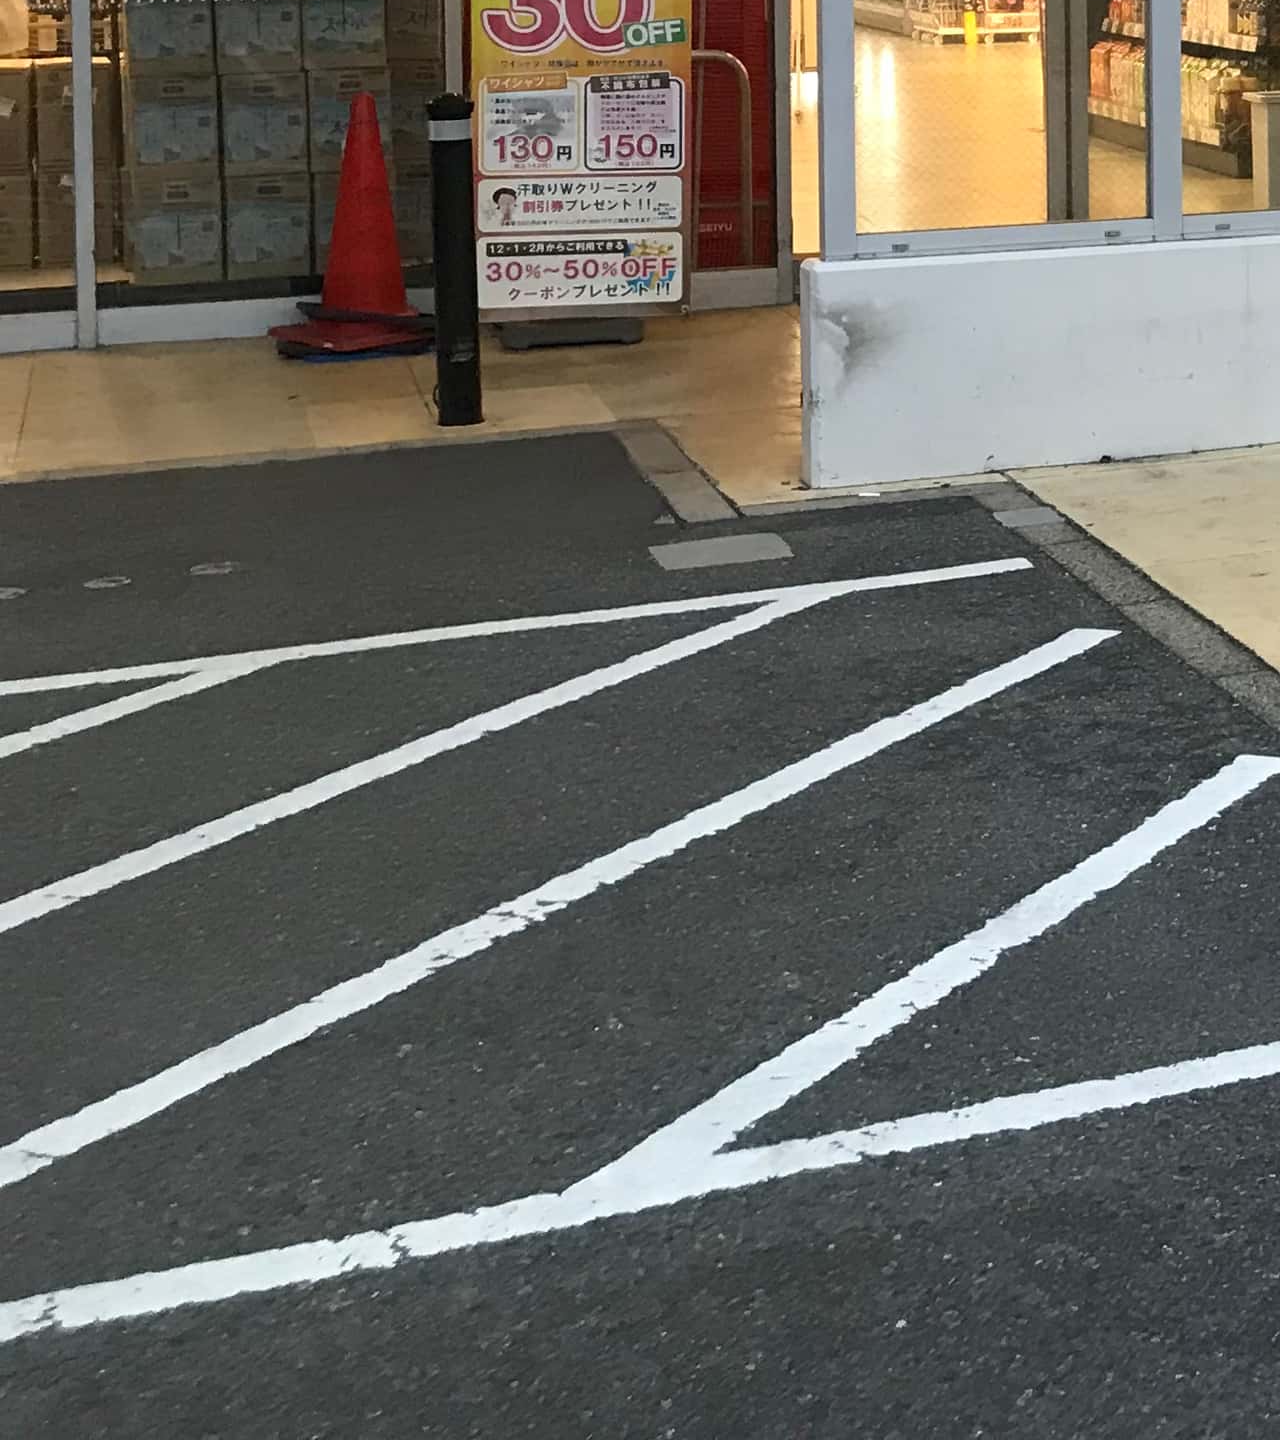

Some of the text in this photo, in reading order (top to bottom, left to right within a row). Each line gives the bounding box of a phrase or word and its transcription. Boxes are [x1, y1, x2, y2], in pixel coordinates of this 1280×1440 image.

[625, 20, 683, 46] OFF
[489, 75, 544, 89] ワイシャツ
[517, 180, 657, 197] 汗取りWクリーニング
